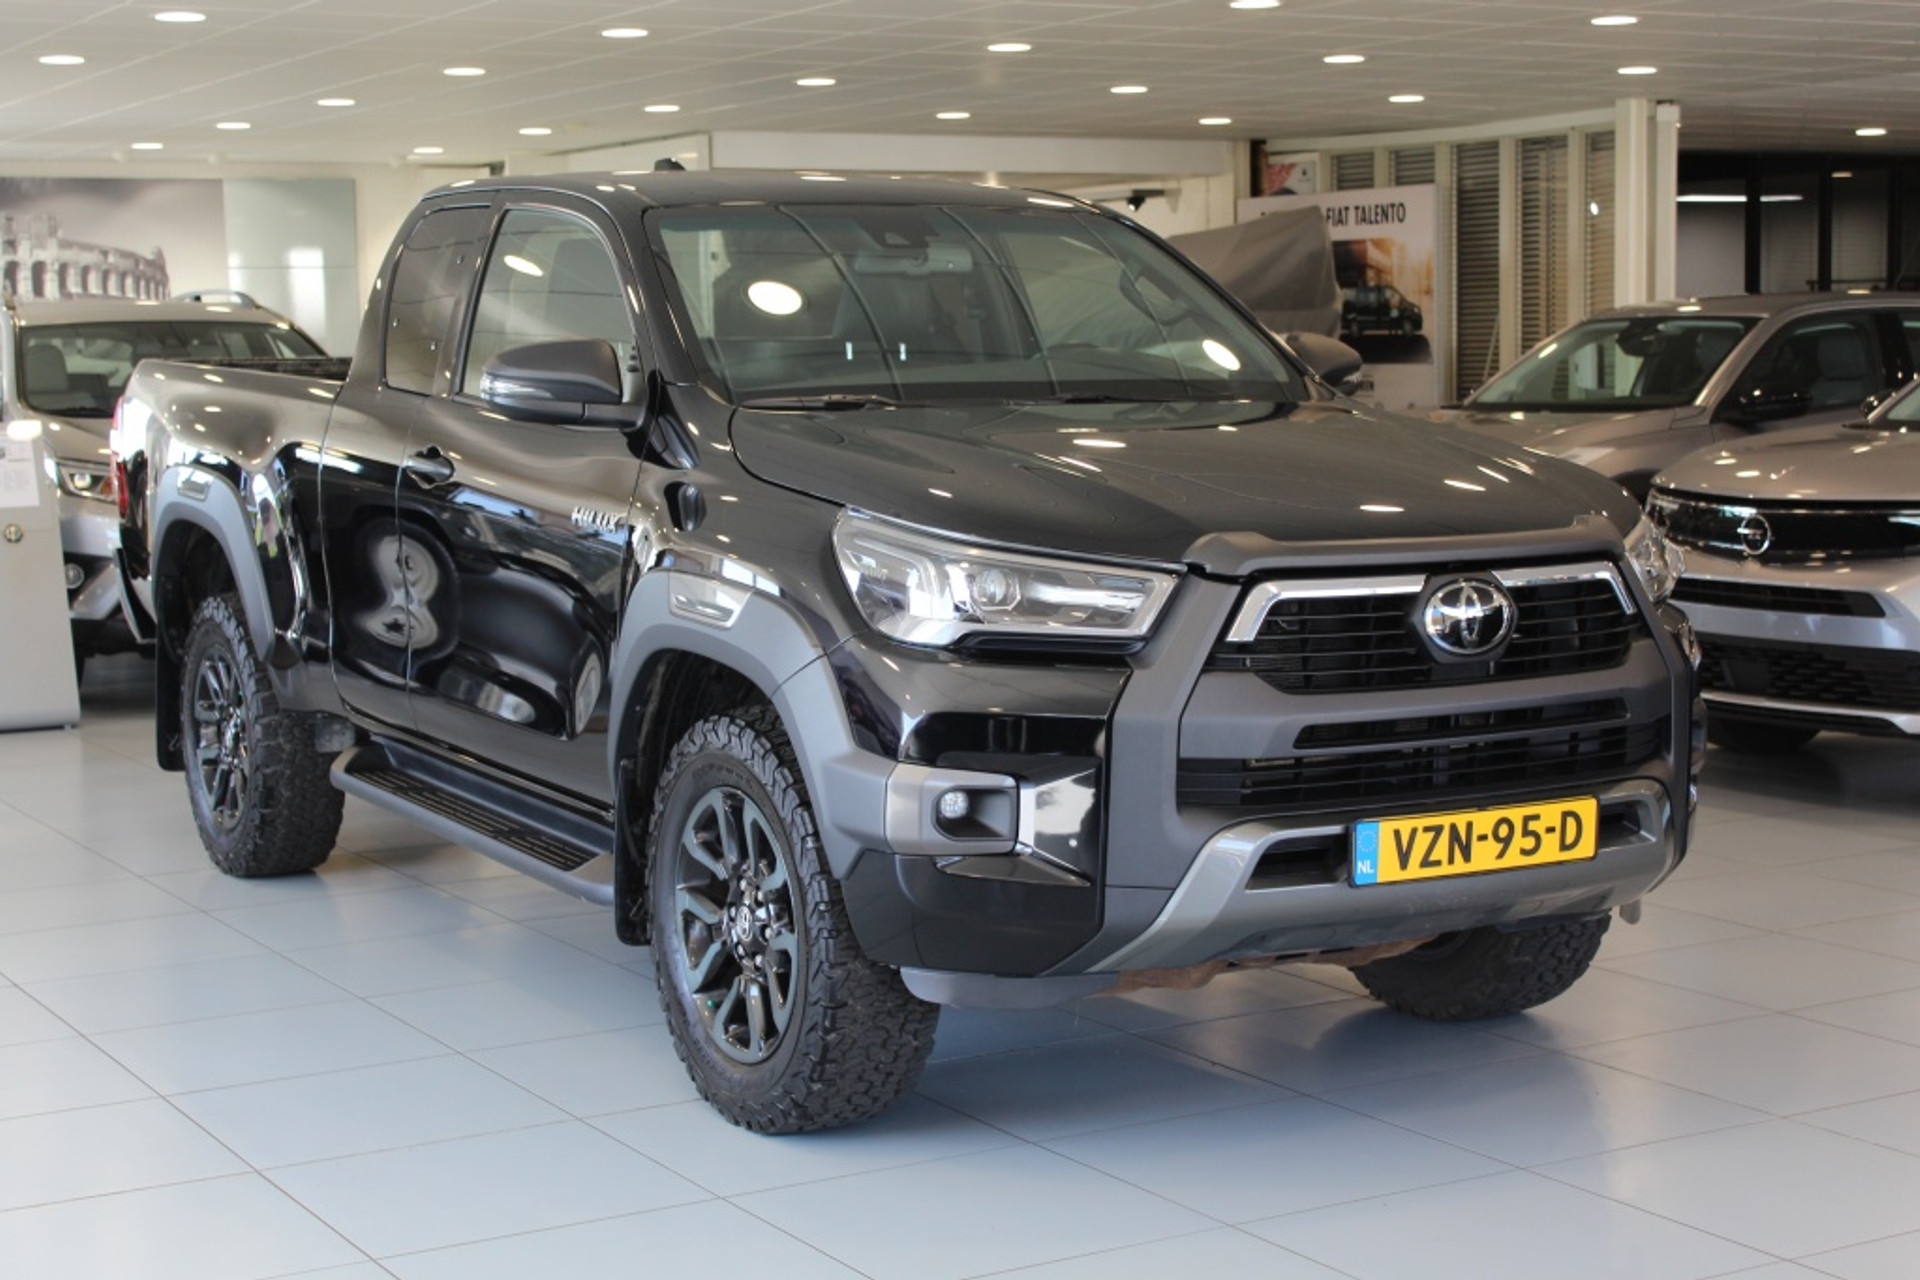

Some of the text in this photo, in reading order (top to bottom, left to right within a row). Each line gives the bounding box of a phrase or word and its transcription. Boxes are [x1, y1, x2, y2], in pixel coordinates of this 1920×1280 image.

[1326, 202, 1406, 227] FIAT TALENTO
[1357, 810, 1583, 875] NL VZN-95-D
